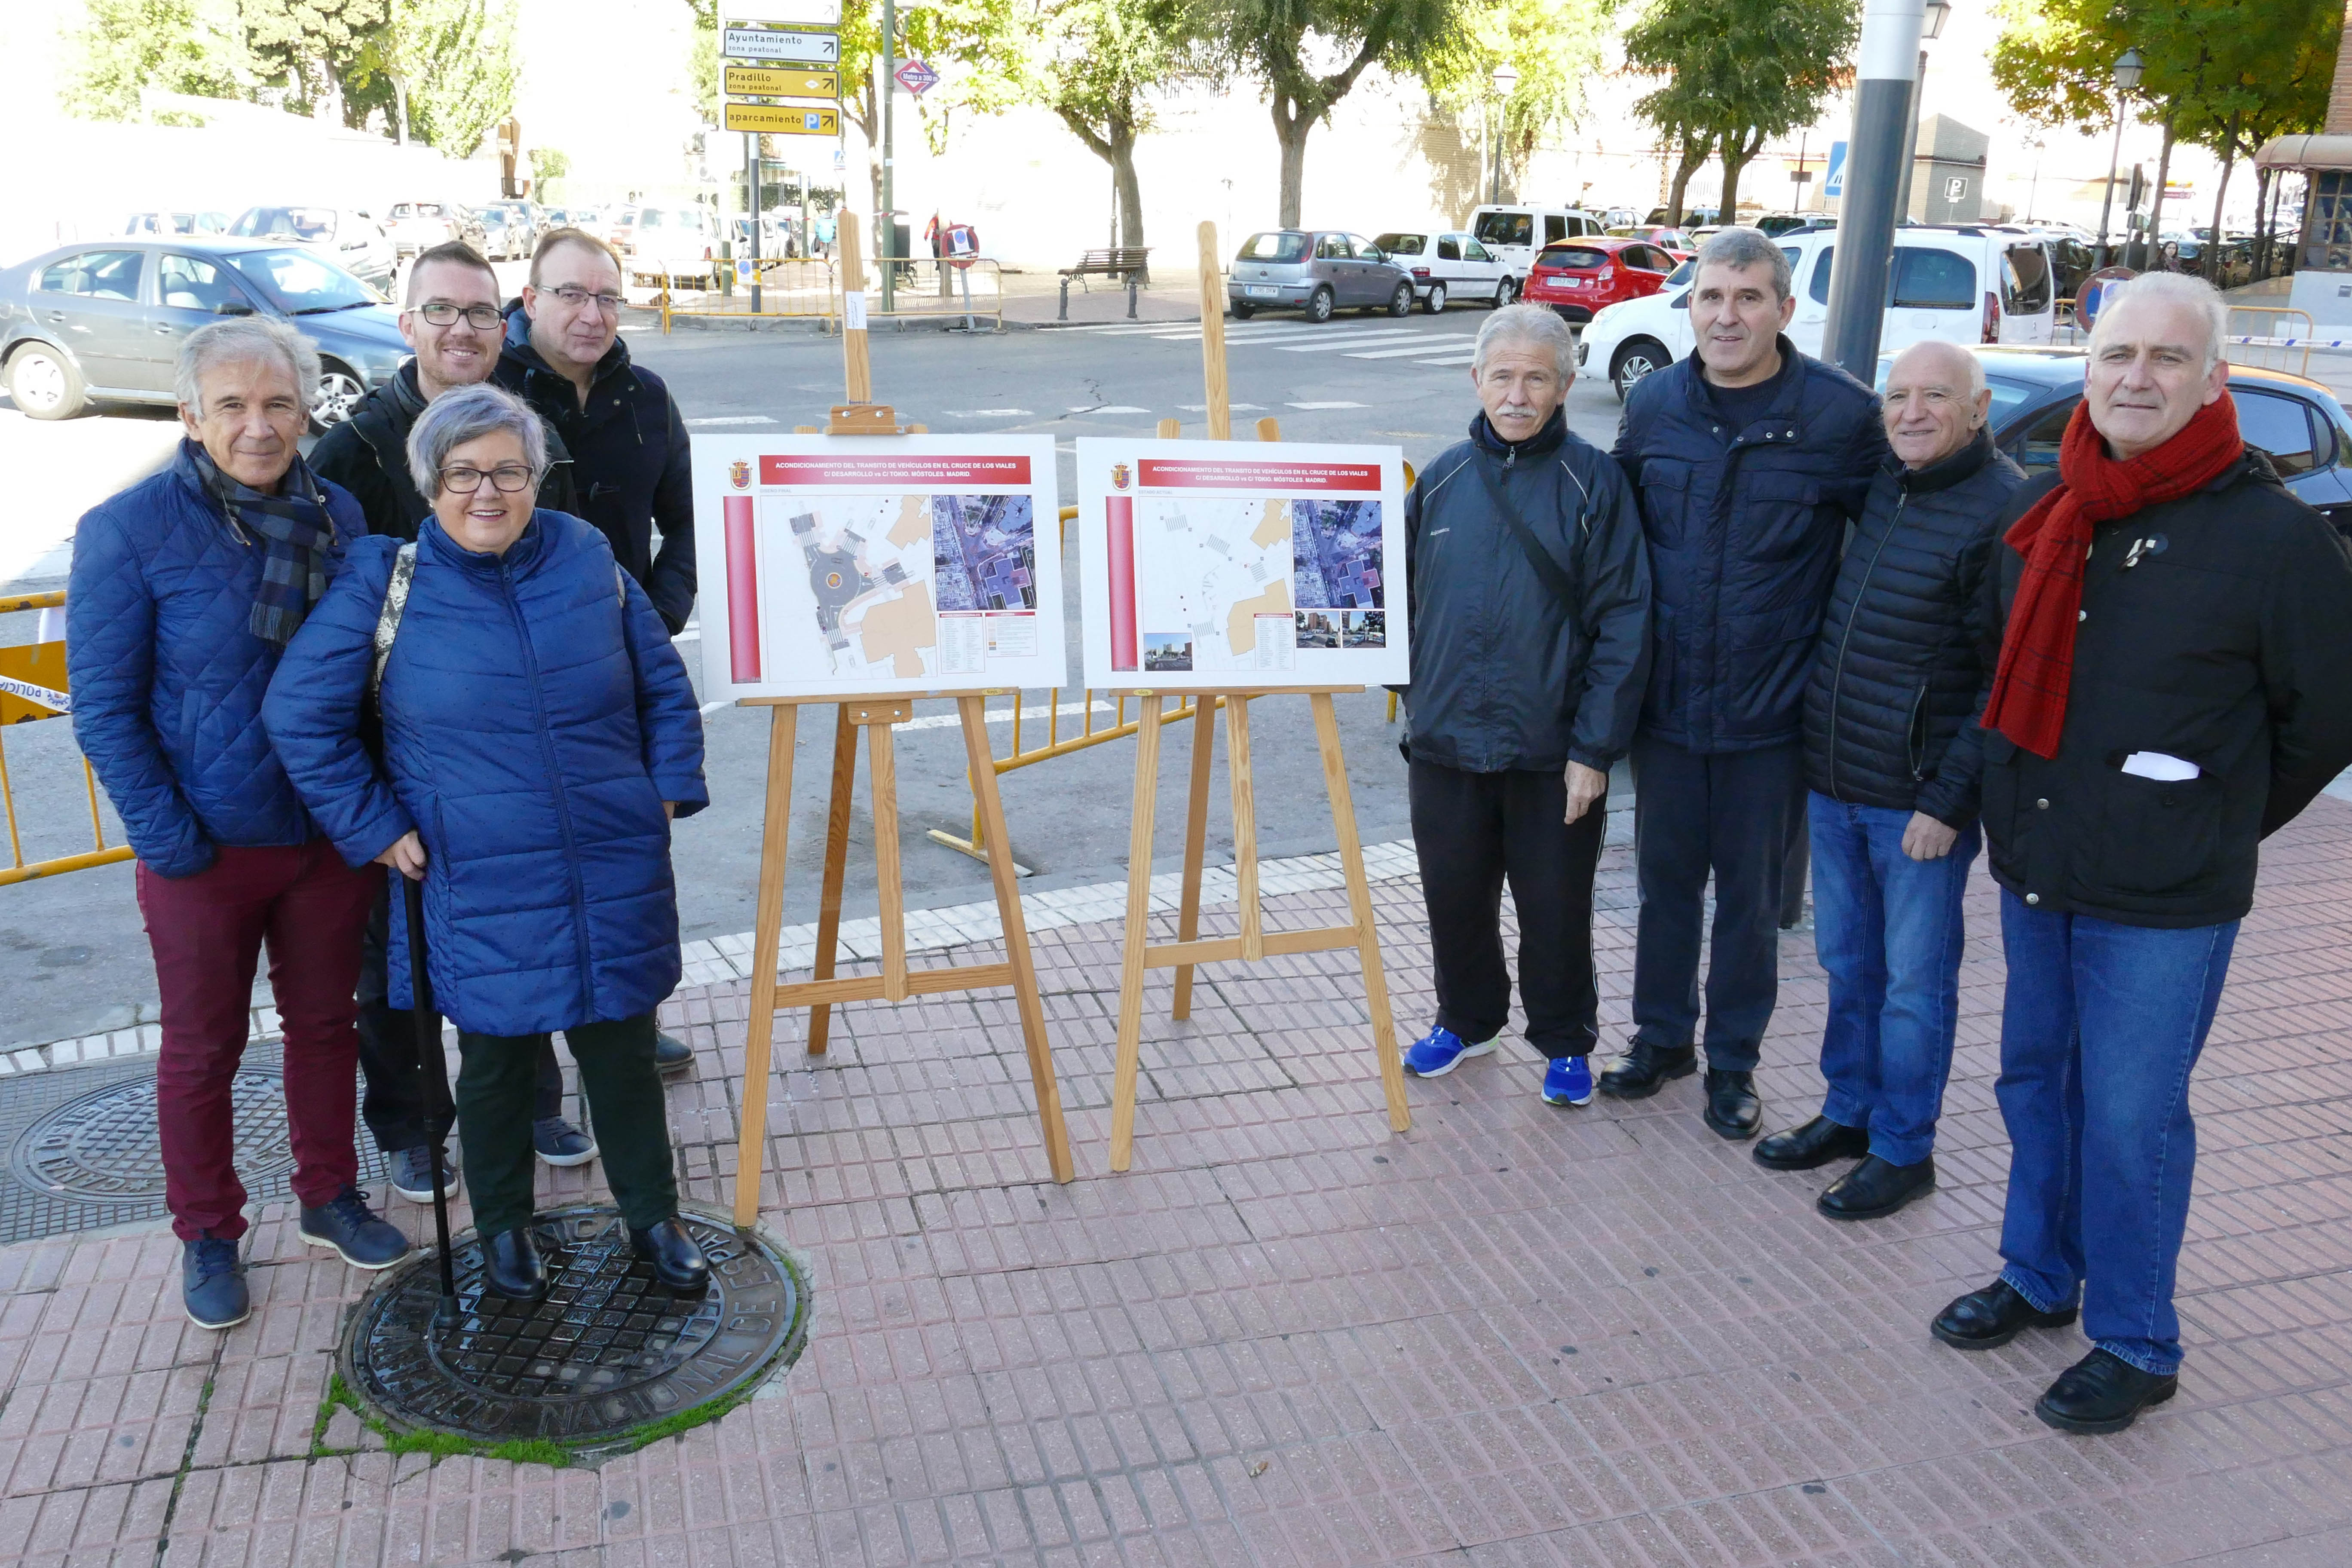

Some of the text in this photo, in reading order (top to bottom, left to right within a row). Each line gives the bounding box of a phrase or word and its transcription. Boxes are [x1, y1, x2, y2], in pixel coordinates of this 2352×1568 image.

[729, 33, 802, 44] Ayuntamiento
[729, 72, 771, 82] Pradillo
[729, 113, 802, 124] aparcamiento
[537, 1351, 753, 1436] NACIONAL
[728, 1300, 776, 1333] DE
